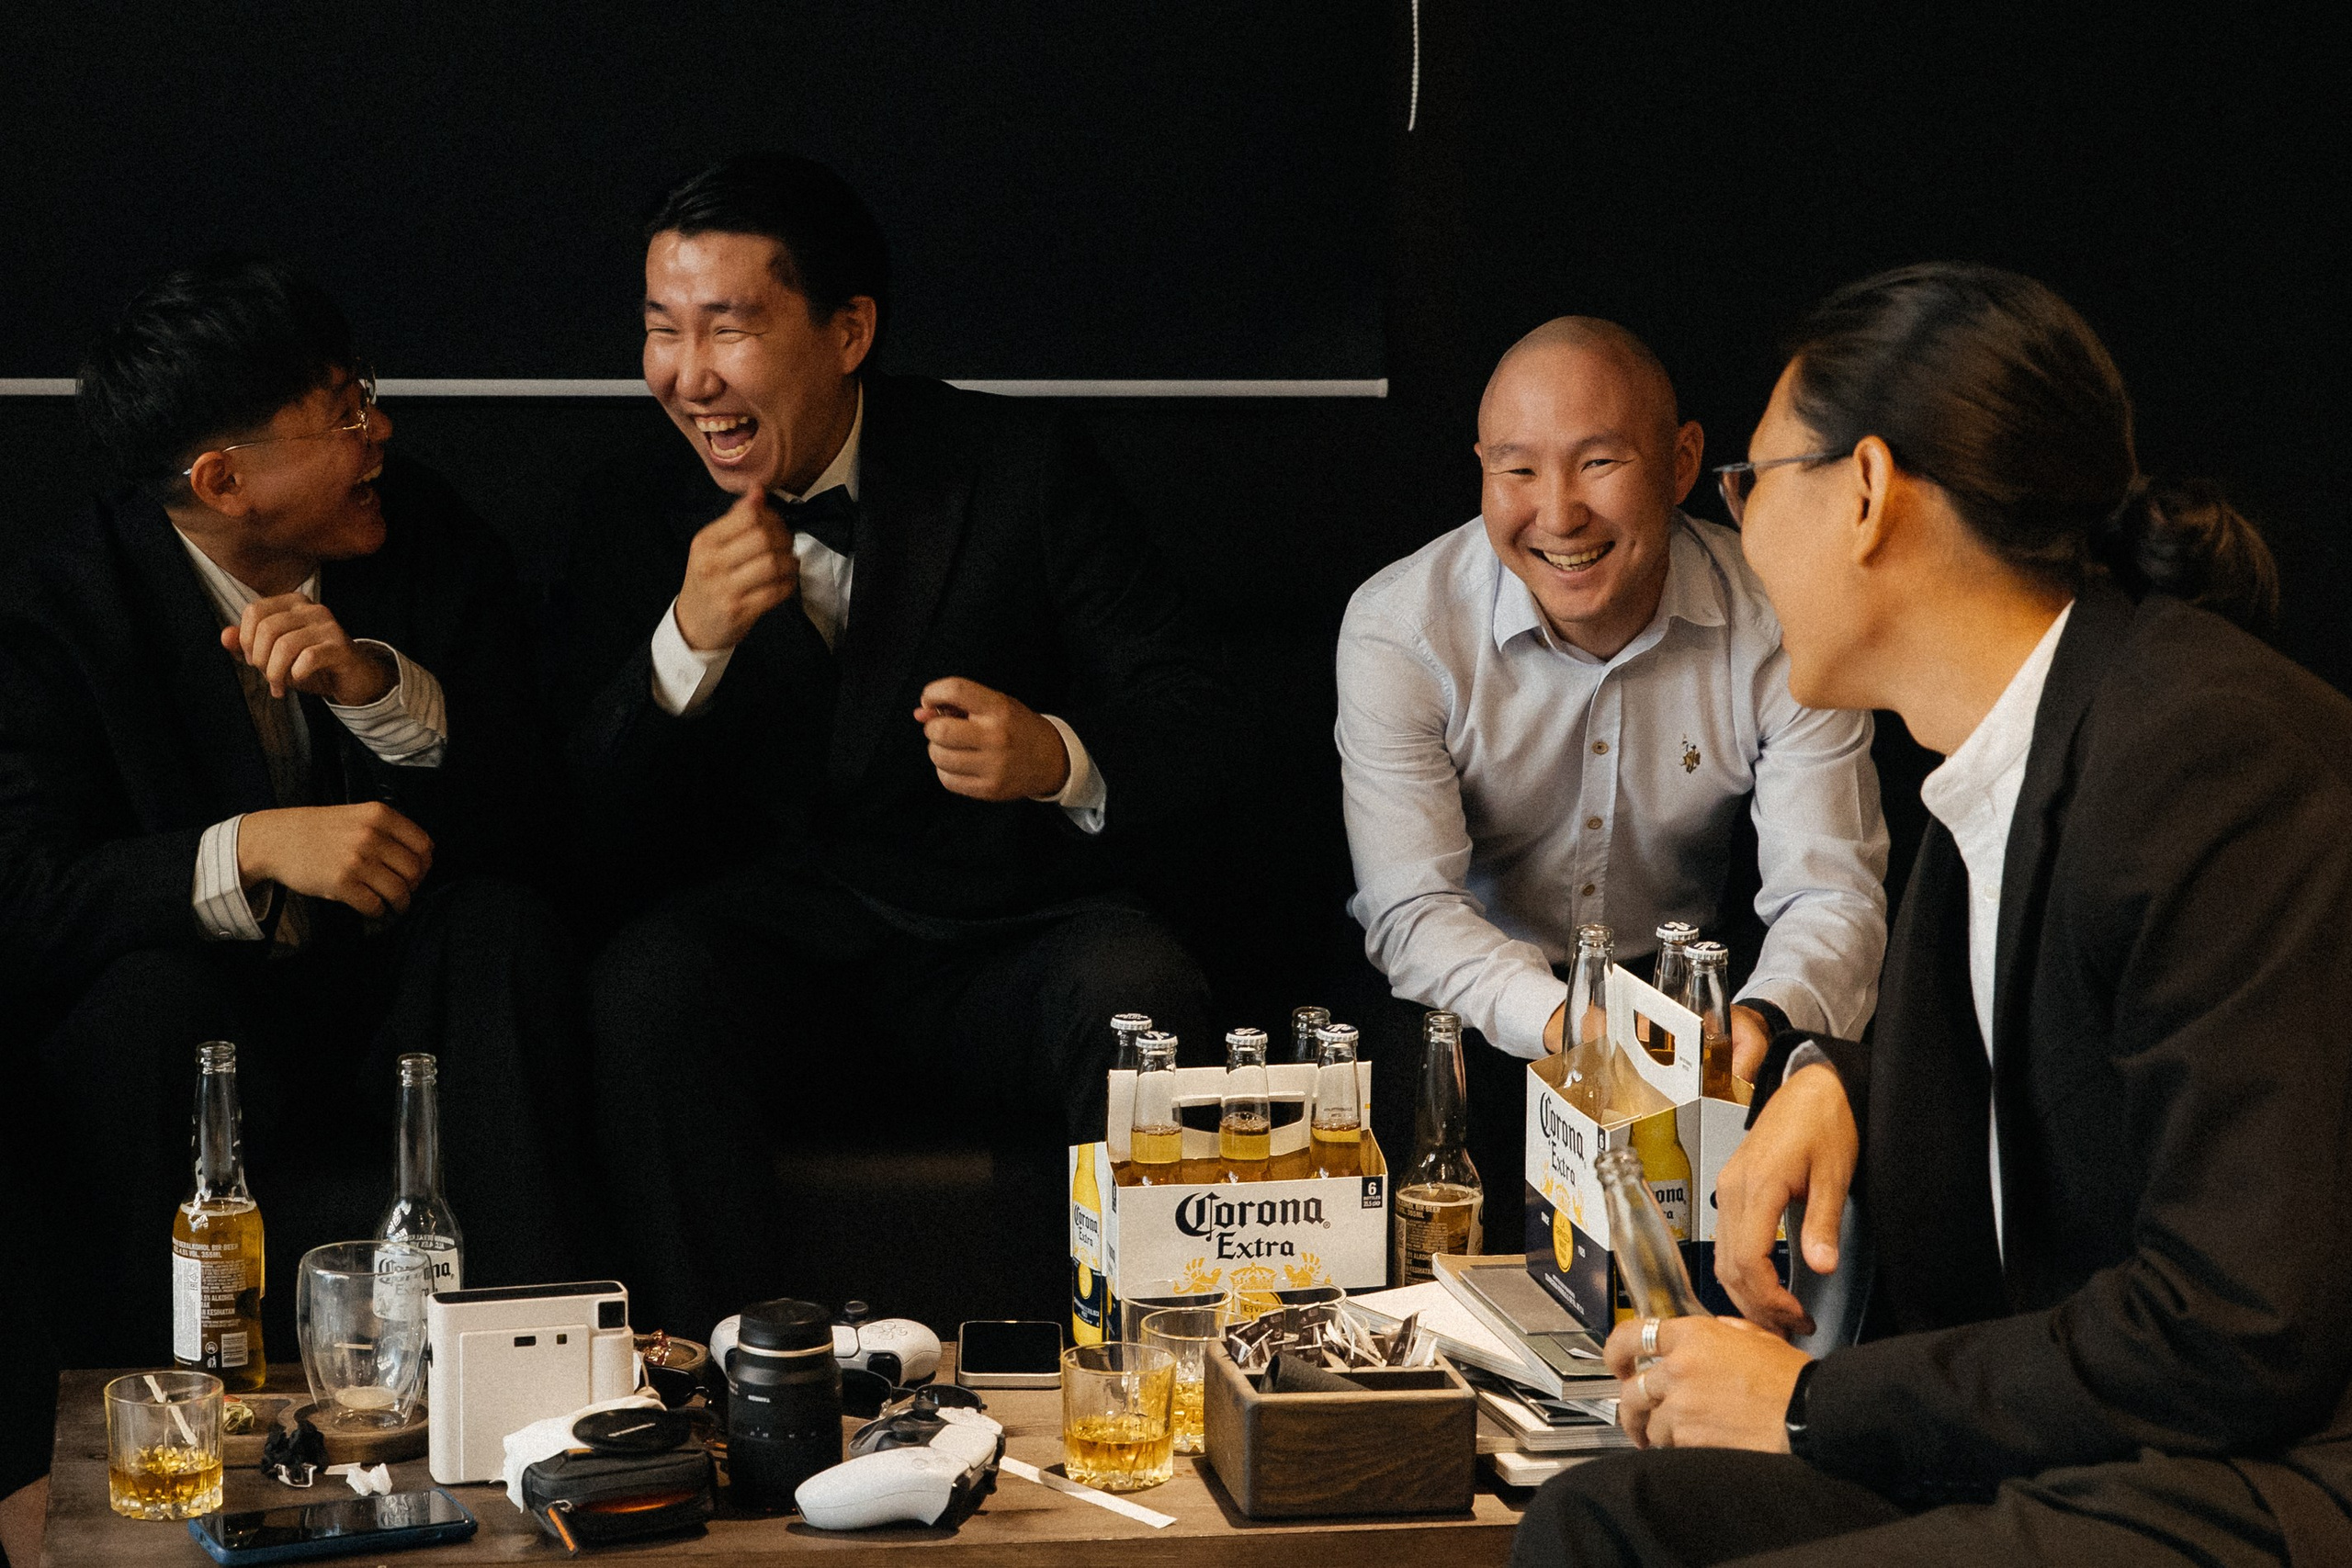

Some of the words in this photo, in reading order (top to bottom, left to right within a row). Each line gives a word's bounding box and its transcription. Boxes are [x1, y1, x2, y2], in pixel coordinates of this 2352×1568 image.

[1540, 1091, 1585, 1161] Corona
[1548, 1139, 1576, 1187] Extra
[1367, 1181, 1377, 1195] 6
[1655, 1188, 1684, 1203] ona
[1073, 1204, 1098, 1233] Corona
[1175, 1191, 1325, 1242] Corona
[1078, 1226, 1093, 1247] Extra
[1216, 1231, 1296, 1259] Extra
